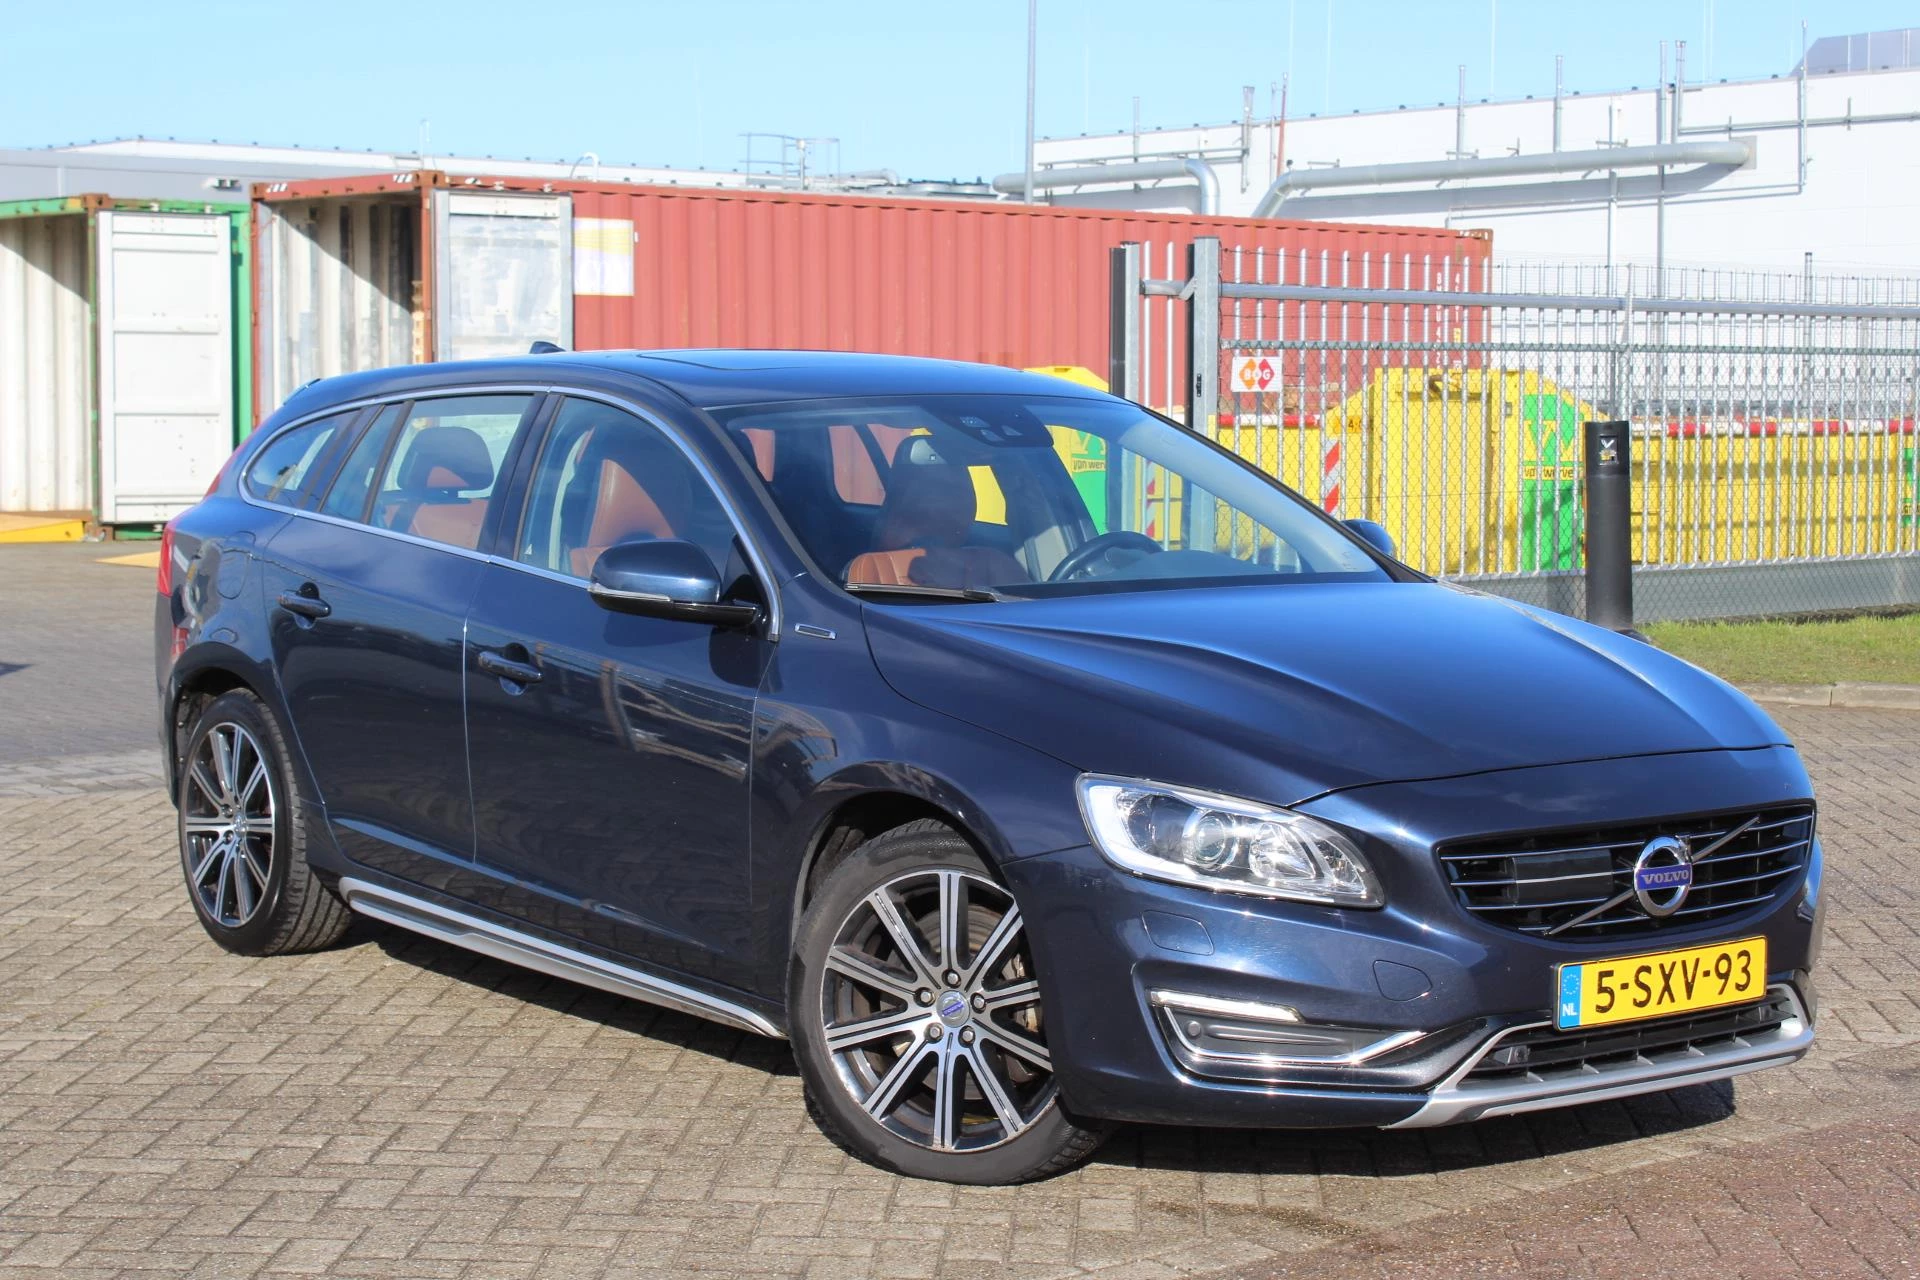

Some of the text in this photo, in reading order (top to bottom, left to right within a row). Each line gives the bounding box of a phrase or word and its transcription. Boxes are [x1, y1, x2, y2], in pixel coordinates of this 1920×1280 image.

[1641, 869, 1690, 885] VOLVO
[1594, 949, 1751, 1013] 5-SXV-93
[1562, 1002, 1578, 1016] NL
